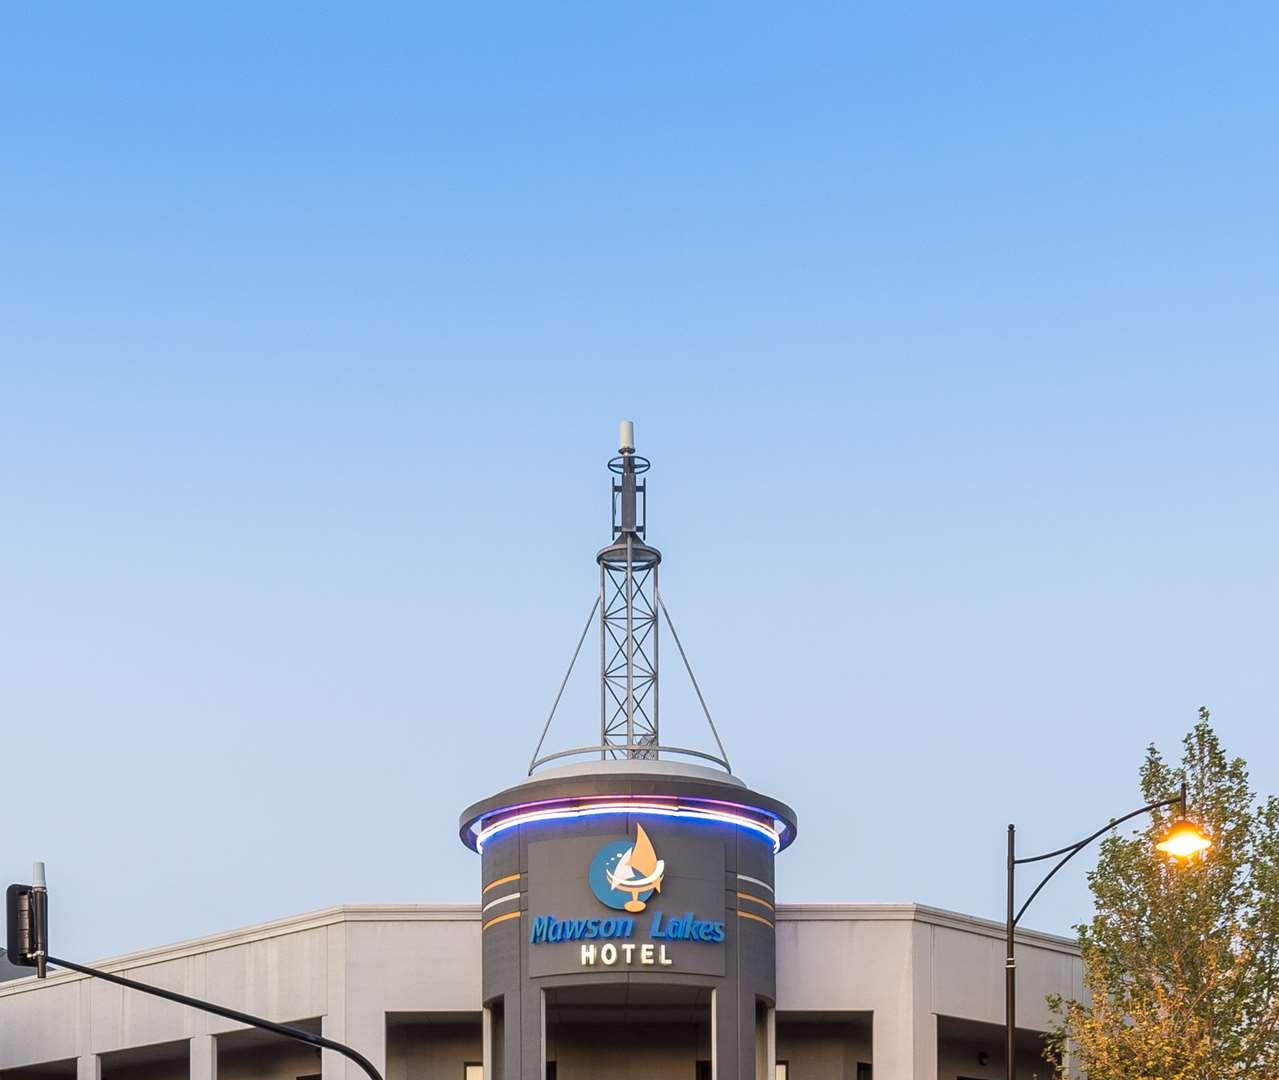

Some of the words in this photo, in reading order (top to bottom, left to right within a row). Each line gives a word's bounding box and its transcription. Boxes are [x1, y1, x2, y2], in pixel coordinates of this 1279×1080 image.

[530, 915, 635, 944] Mawson
[650, 911, 725, 942] Lakes
[581, 943, 672, 965] HOTEL
